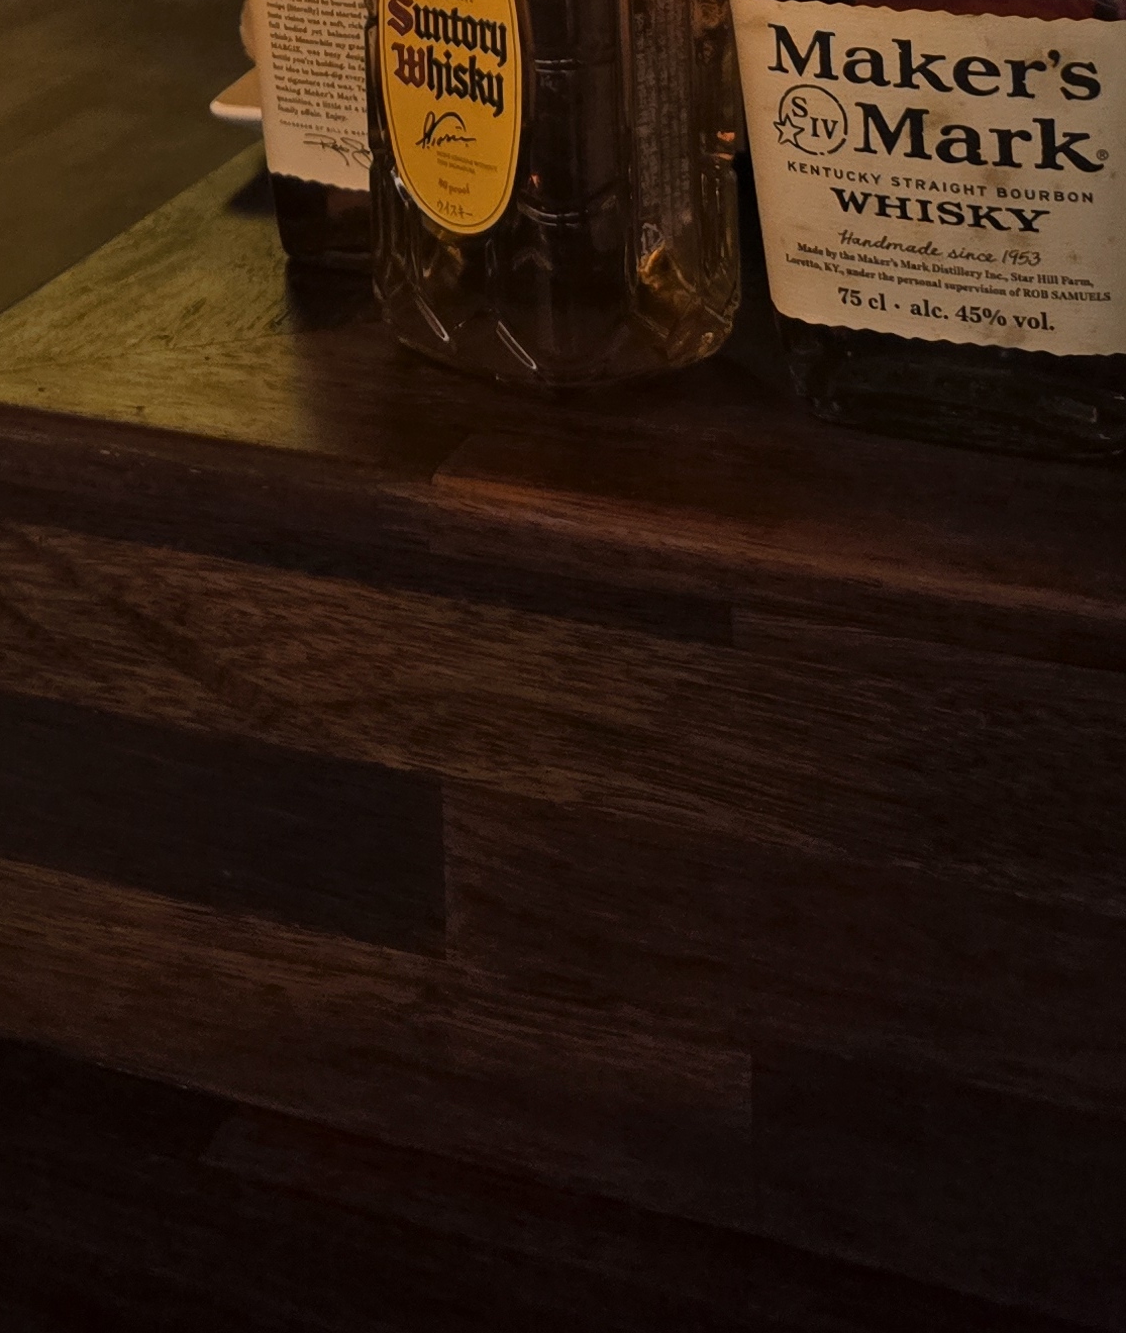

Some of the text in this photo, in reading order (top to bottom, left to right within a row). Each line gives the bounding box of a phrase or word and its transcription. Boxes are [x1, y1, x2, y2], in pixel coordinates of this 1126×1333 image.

[391, 41, 505, 119] Whisky
[767, 23, 1102, 101] Maker's
[791, 96, 809, 118] S
[786, 160, 1094, 203] KENTUCKY STRAIGHT BOURBON
[829, 187, 1051, 233] WHISKY
[797, 242, 824, 256] Made
[825, 247, 838, 260] by
[839, 250, 856, 261] the
[857, 253, 899, 268] Maker's
[932, 264, 983, 280] Distillery
[1010, 272, 1034, 284] Star
[1037, 273, 1059, 285] Hill
[1061, 275, 1095, 288] Farm,
[837, 229, 1042, 266] Handmade since 1953
[846, 267, 876, 279] under
[878, 270, 895, 282] the
[897, 273, 942, 288] personal
[944, 282, 1007, 297] supervision
[1008, 287, 1021, 297] of
[1022, 288, 1049, 299] ROB
[1050, 291, 1112, 302] SAMUELS
[837, 286, 862, 307] 75
[868, 293, 887, 312] cl
[909, 299, 950, 320] alc.
[955, 304, 1007, 326] 45%
[1012, 311, 1056, 331] vol.
